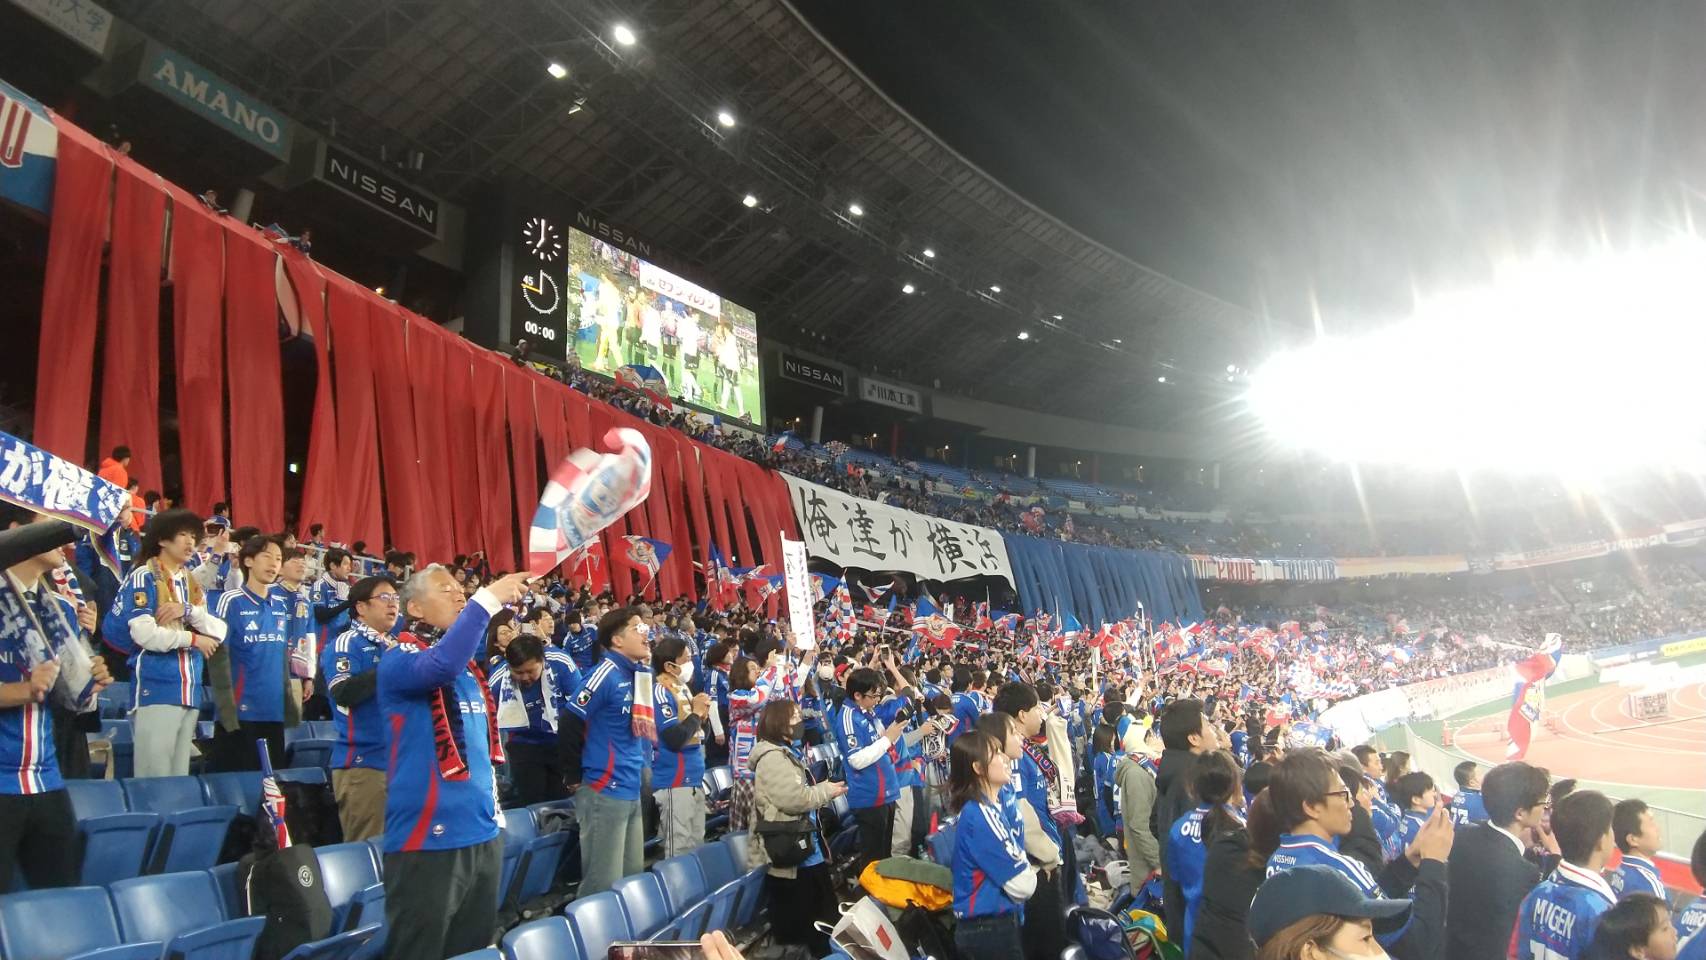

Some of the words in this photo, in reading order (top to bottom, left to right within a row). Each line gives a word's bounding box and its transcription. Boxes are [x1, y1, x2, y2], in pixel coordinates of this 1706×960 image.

[154, 59, 281, 145] AMANO
[329, 157, 434, 224] NISSAN
[577, 211, 651, 256] NISSAN
[522, 275, 534, 286] 45
[524, 320, 555, 341] 00:00
[785, 360, 843, 386] NISSAN
[798, 486, 1001, 575] 俺達が横浜
[243, 633, 285, 644] NISSA
